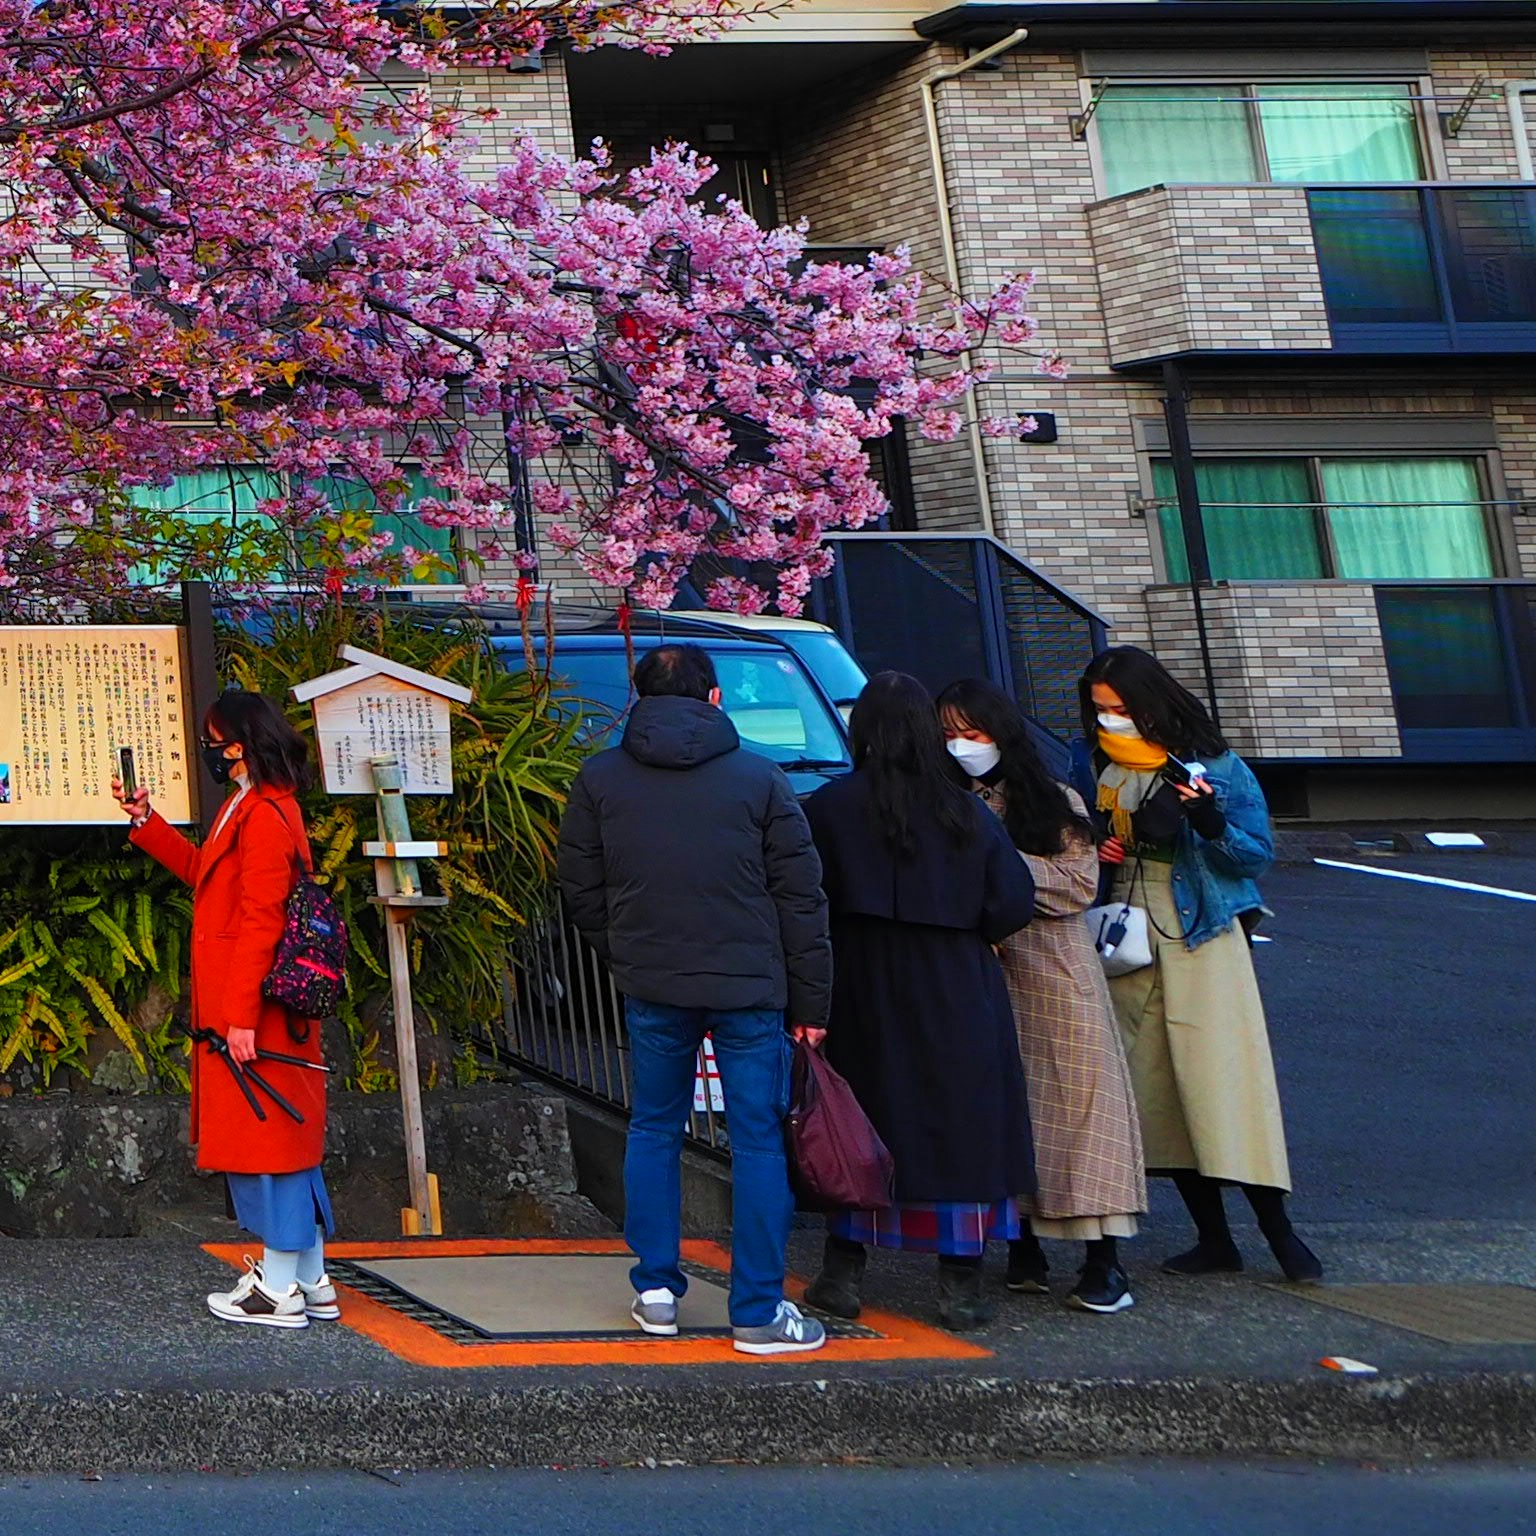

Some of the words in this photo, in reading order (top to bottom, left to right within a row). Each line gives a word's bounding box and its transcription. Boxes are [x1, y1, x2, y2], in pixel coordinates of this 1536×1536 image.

[163, 655, 182, 781] 河津桜原木物語
[785, 1317, 803, 1341] N
